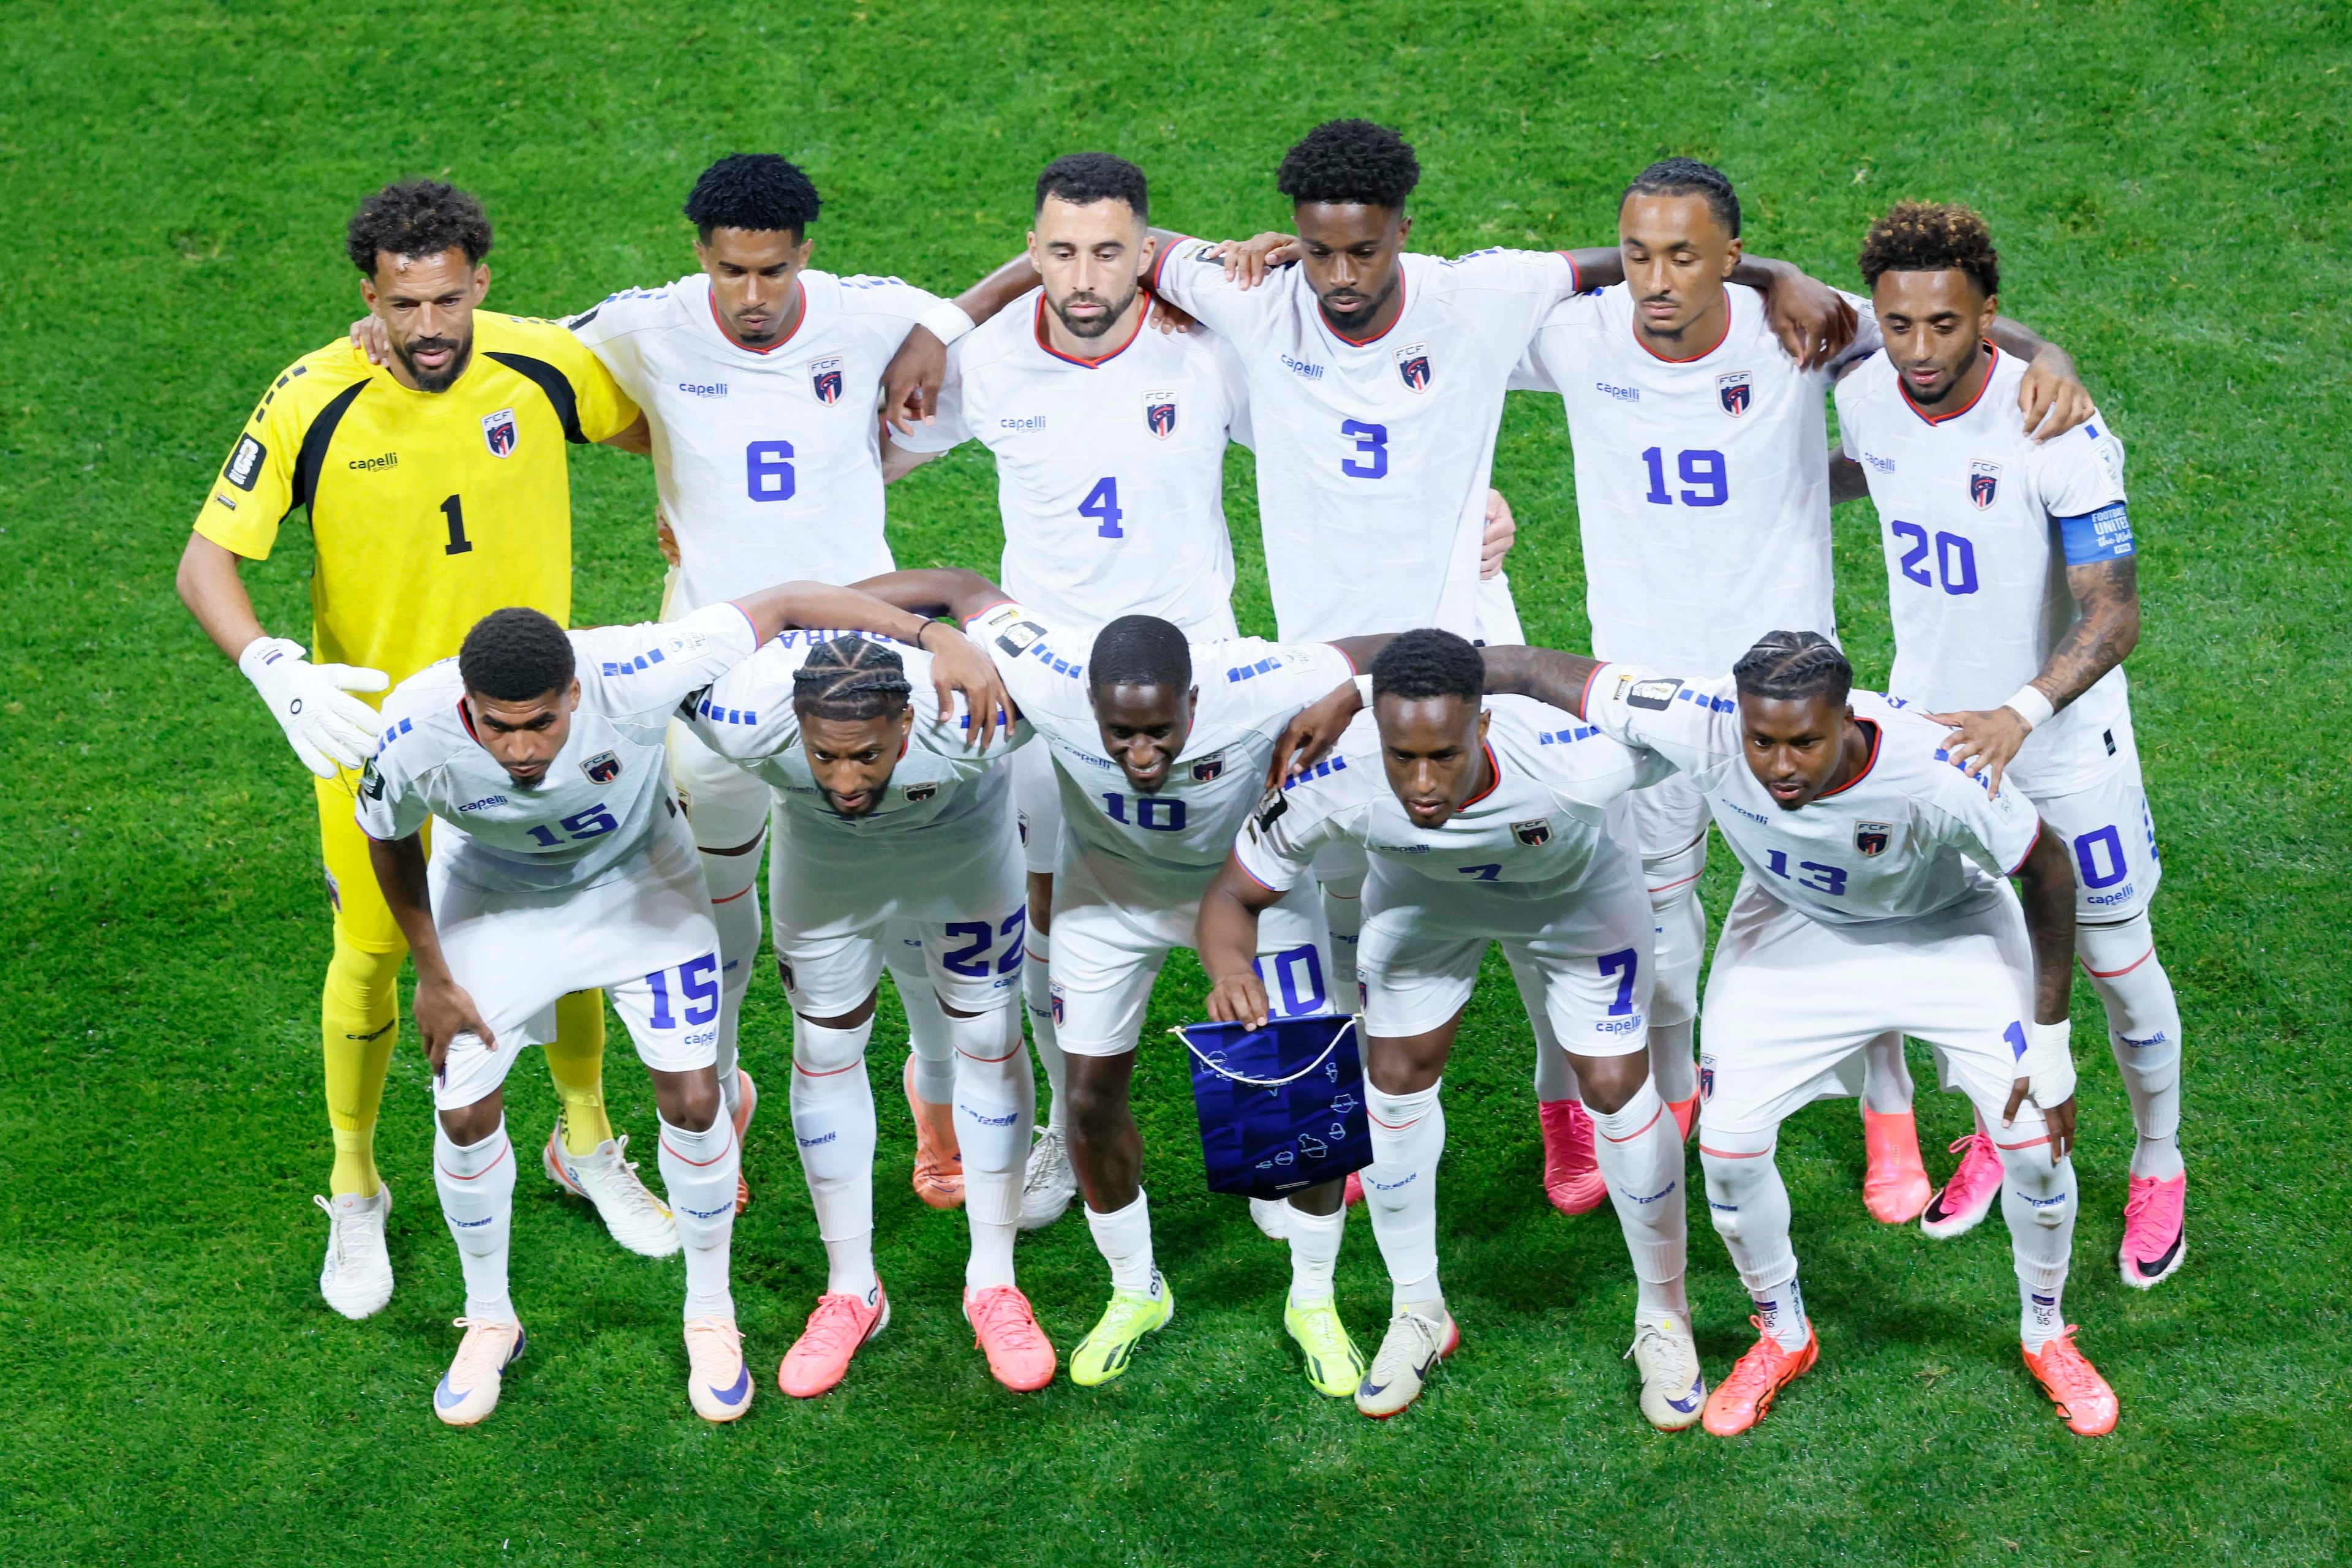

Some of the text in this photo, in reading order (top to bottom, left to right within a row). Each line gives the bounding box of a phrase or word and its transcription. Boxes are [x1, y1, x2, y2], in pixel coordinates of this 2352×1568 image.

[1396, 345, 1422, 359] FCF
[812, 360, 839, 371] FCF
[1281, 354, 1323, 379] capelli
[679, 383, 728, 396] capelli
[1719, 374, 1748, 384] FCF
[1596, 382, 1639, 400] capelli
[484, 411, 510, 426] FCF
[1001, 416, 1046, 431] capelli
[1341, 419, 1387, 479] 3
[349, 452, 398, 471] capelli
[747, 440, 795, 502] 6
[1865, 453, 1895, 471] capelli
[1973, 462, 1999, 472] FCF
[1642, 447, 1728, 507] 19
[1078, 477, 1123, 538] 4
[440, 494, 472, 555] 1
[1891, 520, 1978, 595] 20
[584, 752, 611, 769] FCF
[459, 795, 508, 812] capelli
[1103, 793, 1185, 831] 10
[528, 804, 619, 846] 15
[2064, 825, 2127, 889] 0
[1458, 864, 1502, 881] 7
[1766, 850, 1846, 896] 13
[2087, 883, 2133, 906] capelli
[943, 903, 1026, 978] 22
[646, 952, 718, 1029] 15
[1598, 948, 1638, 1016] 7
[1596, 1015, 1642, 1035] capelli
[960, 1104, 1018, 1125] capelli
[2037, 1316, 2051, 1325] 55
